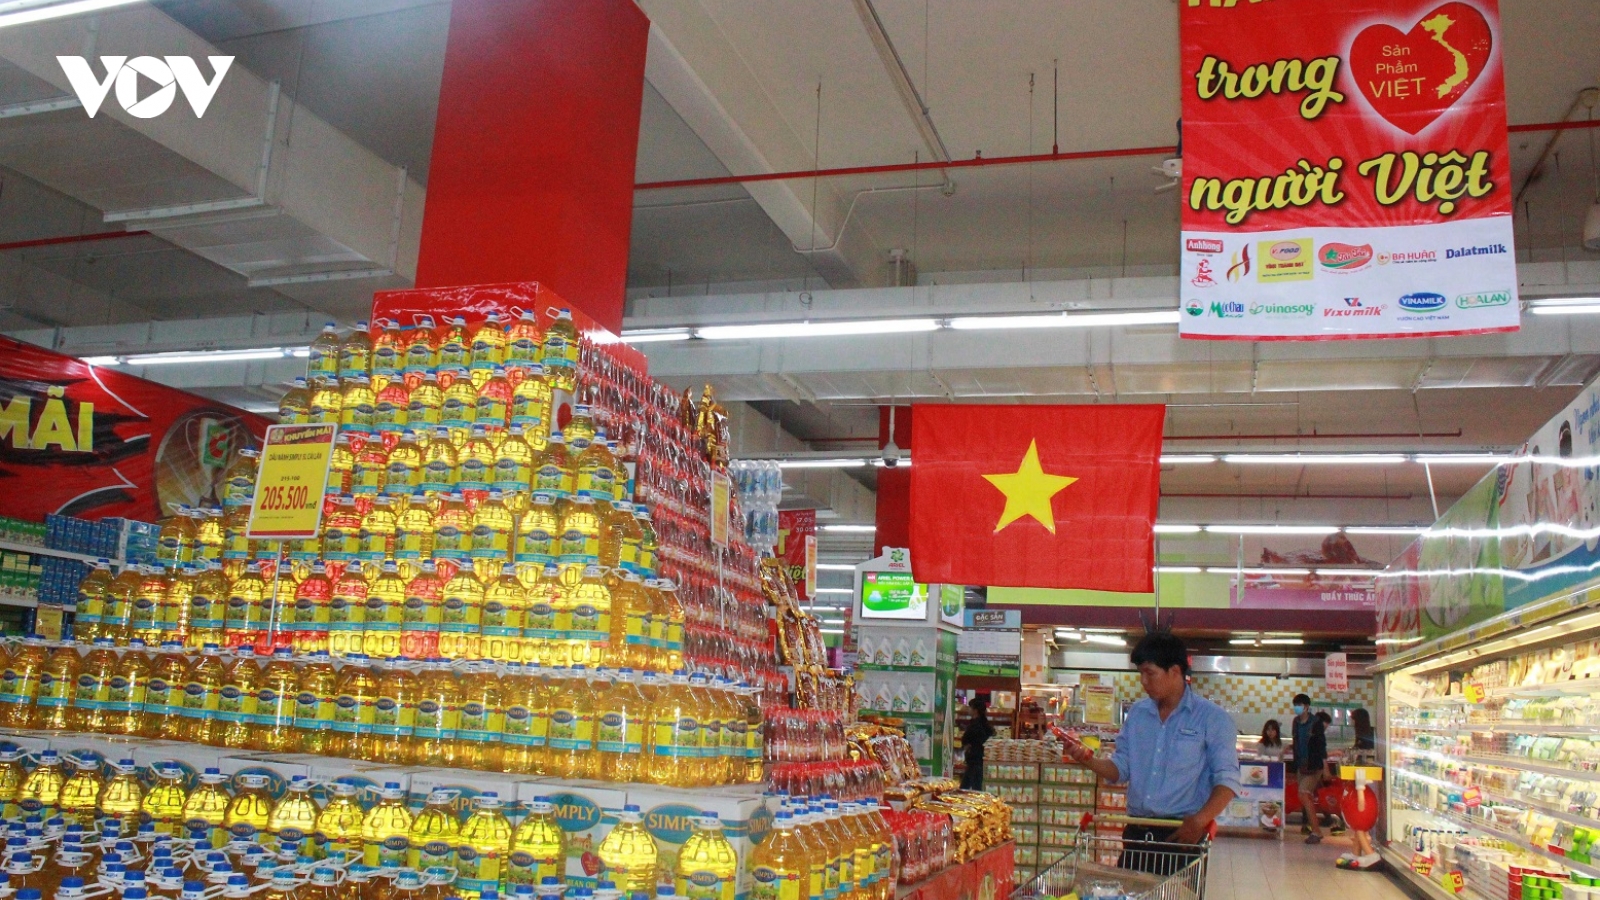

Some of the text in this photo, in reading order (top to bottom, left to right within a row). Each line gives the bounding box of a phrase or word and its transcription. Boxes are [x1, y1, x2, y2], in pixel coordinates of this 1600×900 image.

[1382, 44, 1411, 57] Sản
[1375, 60, 1418, 75] Phẩm
[1195, 54, 1345, 120] trong
[1368, 77, 1427, 101] VIỆT
[1189, 148, 1494, 226] người Việt
[1445, 243, 1507, 260] Dalatmilk
[1265, 302, 1315, 316] vinasoy
[1401, 297, 1444, 305] VINAMILK
[260, 485, 308, 511] 205.500
[553, 804, 596, 821] MPLY
[648, 813, 699, 832] SIMPL
